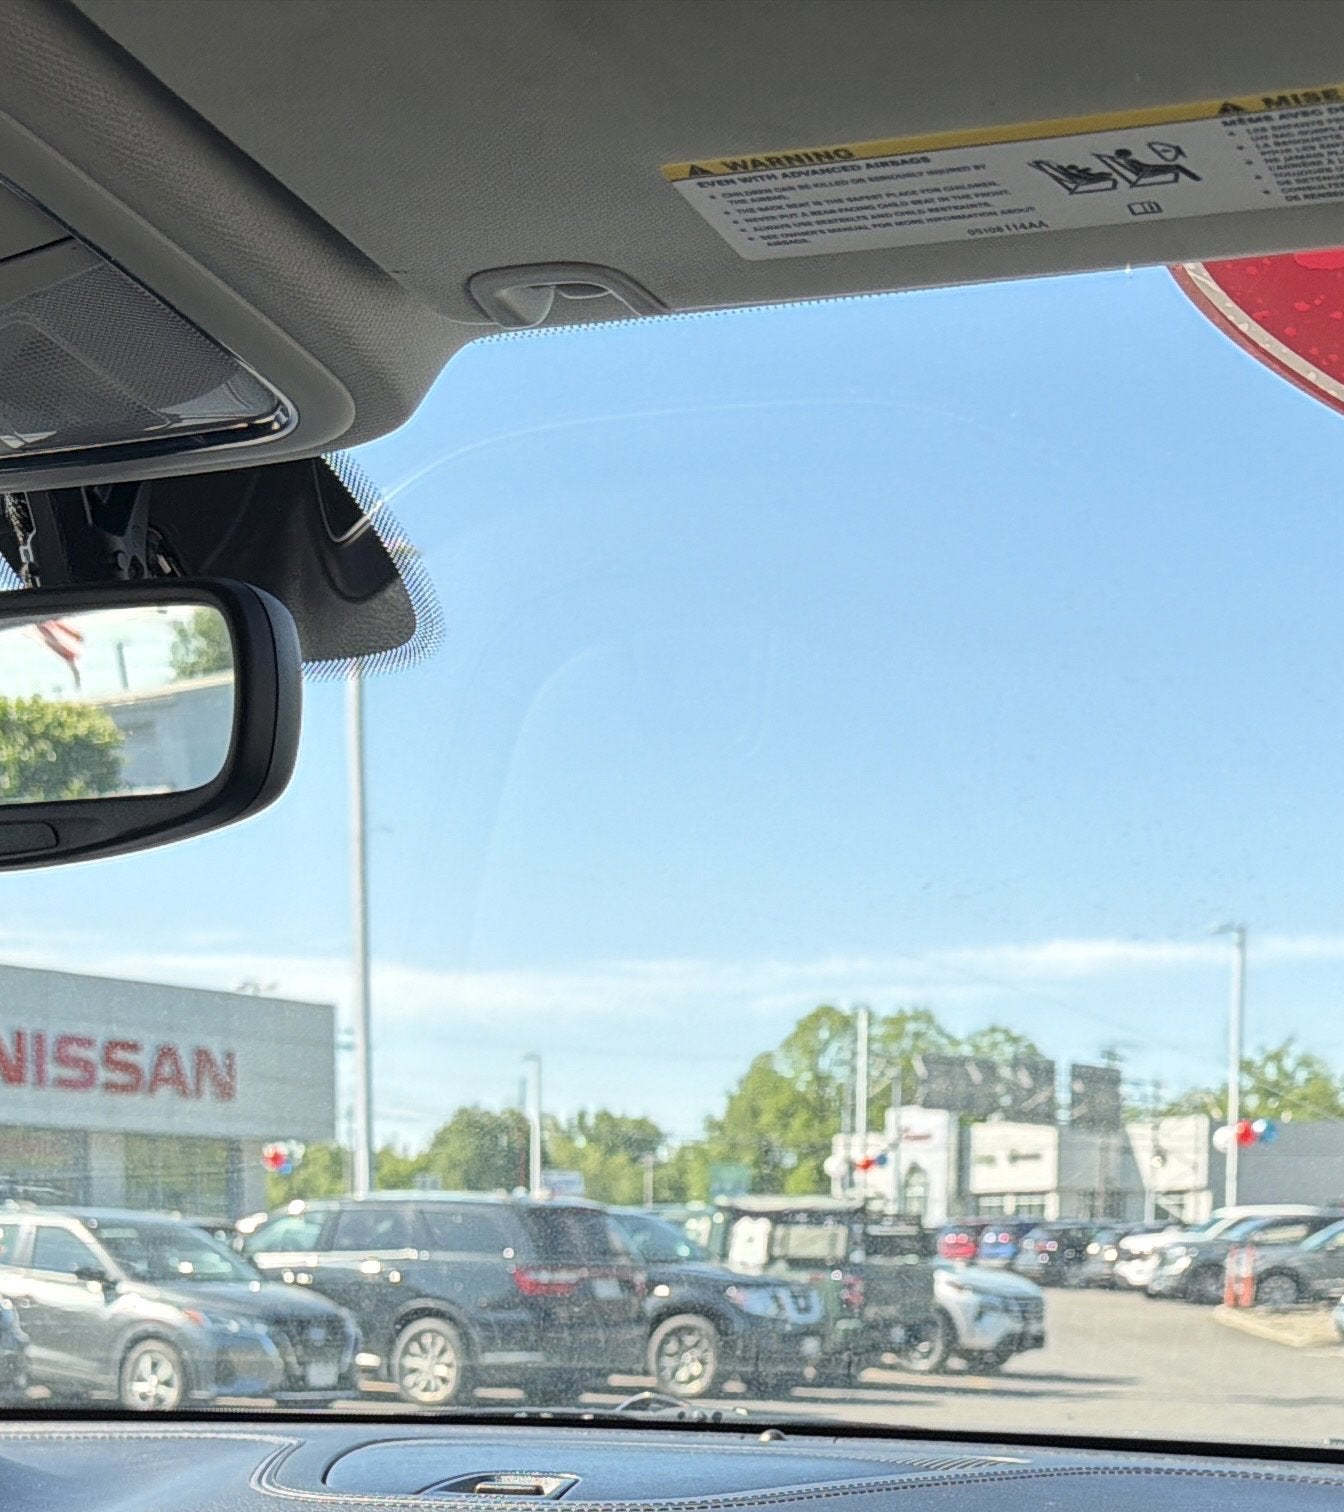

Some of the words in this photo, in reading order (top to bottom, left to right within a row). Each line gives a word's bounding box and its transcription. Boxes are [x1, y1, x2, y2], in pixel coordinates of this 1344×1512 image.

[1261, 87, 1339, 108] MISE
[721, 149, 855, 171] WARNING
[697, 179, 736, 188] EVEN
[737, 173, 778, 185] WITH
[781, 165, 861, 179] ADVANCED
[866, 156, 931, 170] AIRBAGS
